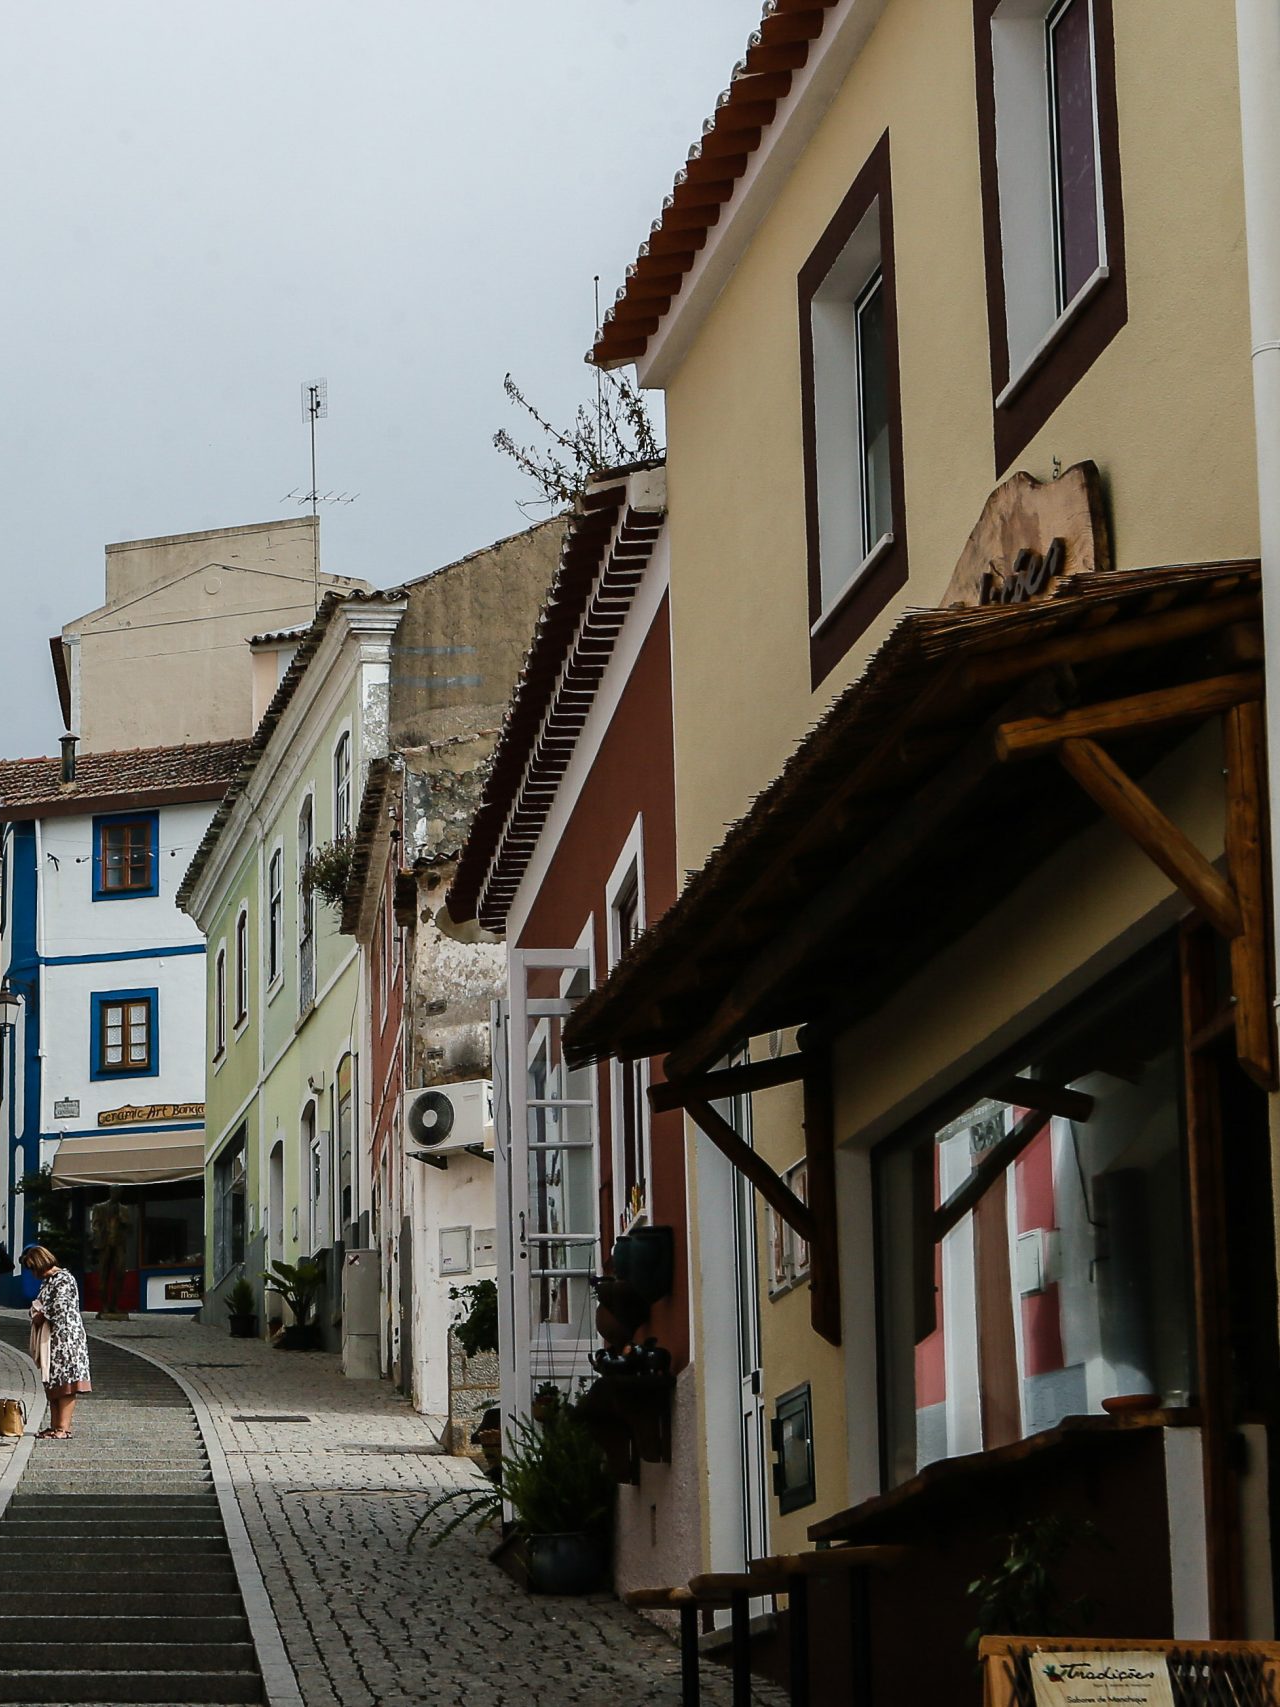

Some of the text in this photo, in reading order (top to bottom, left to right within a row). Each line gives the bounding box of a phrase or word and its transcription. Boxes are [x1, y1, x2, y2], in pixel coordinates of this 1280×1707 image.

[98, 1108, 143, 1124] Ceramic
[146, 1106, 168, 1119] Art
[1060, 1662, 1155, 1683] Tradições
